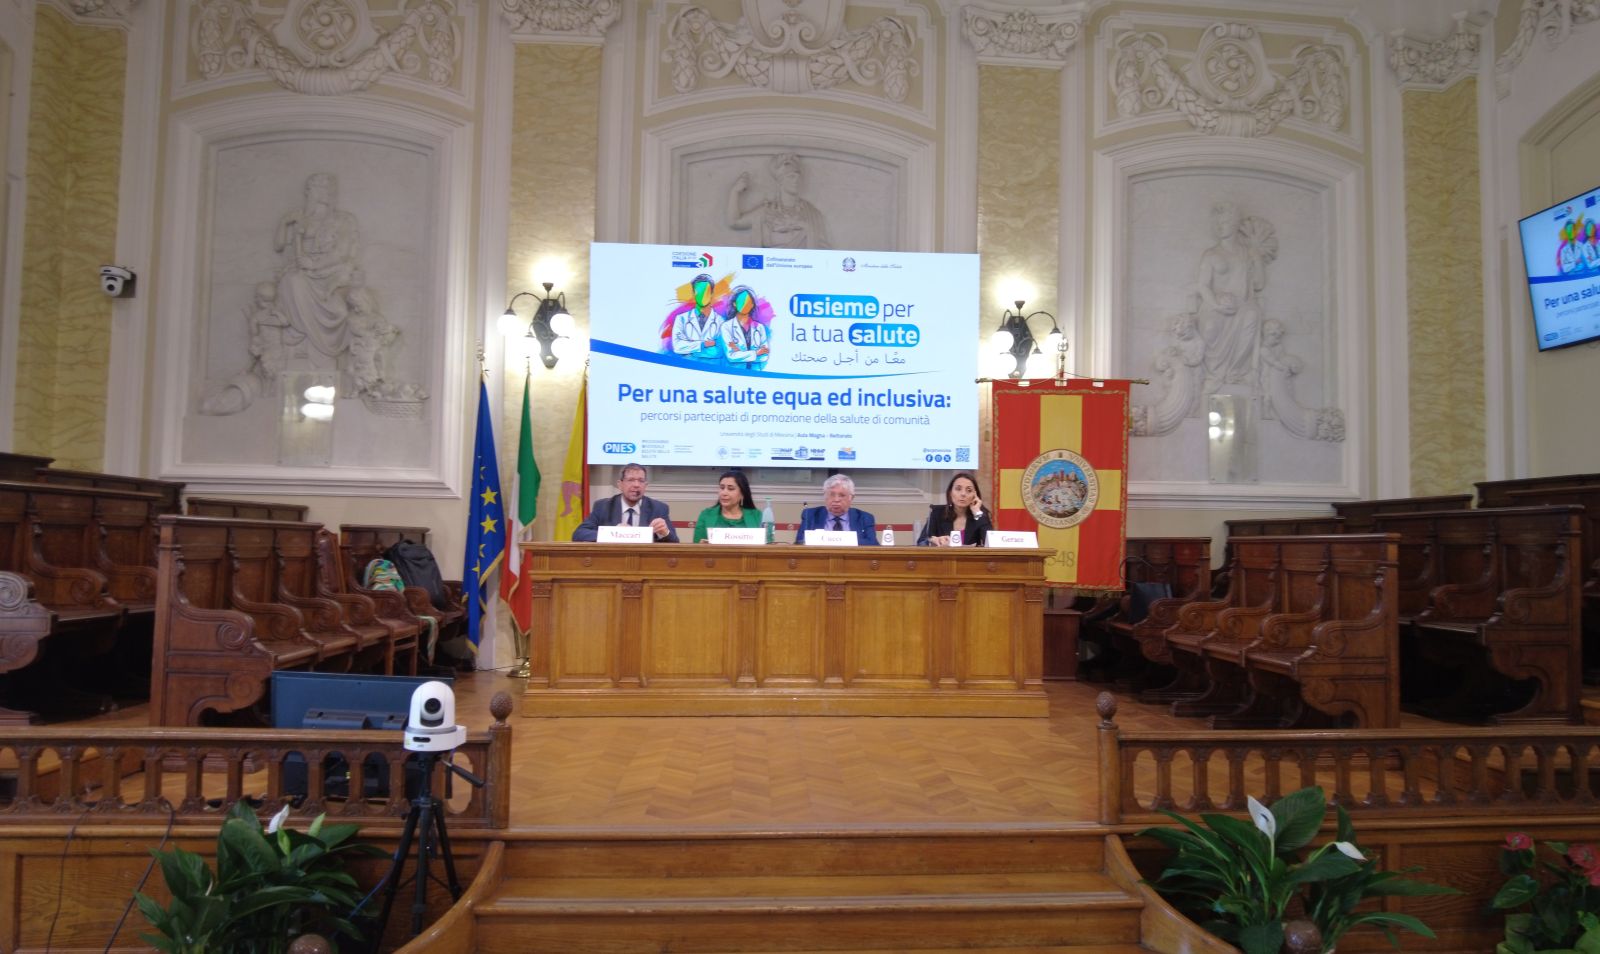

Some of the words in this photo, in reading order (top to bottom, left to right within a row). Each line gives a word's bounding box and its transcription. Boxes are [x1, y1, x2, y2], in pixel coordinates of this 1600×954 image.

[1544, 298, 1560, 310] Per
[1562, 292, 1580, 304] una
[1581, 284, 1600, 299] salu
[792, 296, 877, 316] Insieme
[883, 303, 914, 322] per
[791, 323, 807, 342] la
[812, 325, 844, 342] tua
[852, 325, 918, 345] salute
[834, 349, 859, 366] أجل
[618, 384, 653, 402] Per
[660, 388, 698, 404] una
[704, 386, 767, 404] salute
[772, 390, 822, 410] equa
[828, 388, 852, 406] ed
[858, 388, 951, 408] inclusiva:
[640, 411, 681, 422] percorsi
[684, 412, 738, 424] partecipati
[740, 412, 749, 422] di
[752, 414, 812, 424] promozione
[814, 414, 837, 424] della
[840, 414, 870, 424] salute
[872, 414, 882, 424] di
[884, 414, 930, 426] comunità
[605, 444, 633, 453] PNES
[1047, 551, 1075, 567] 548
